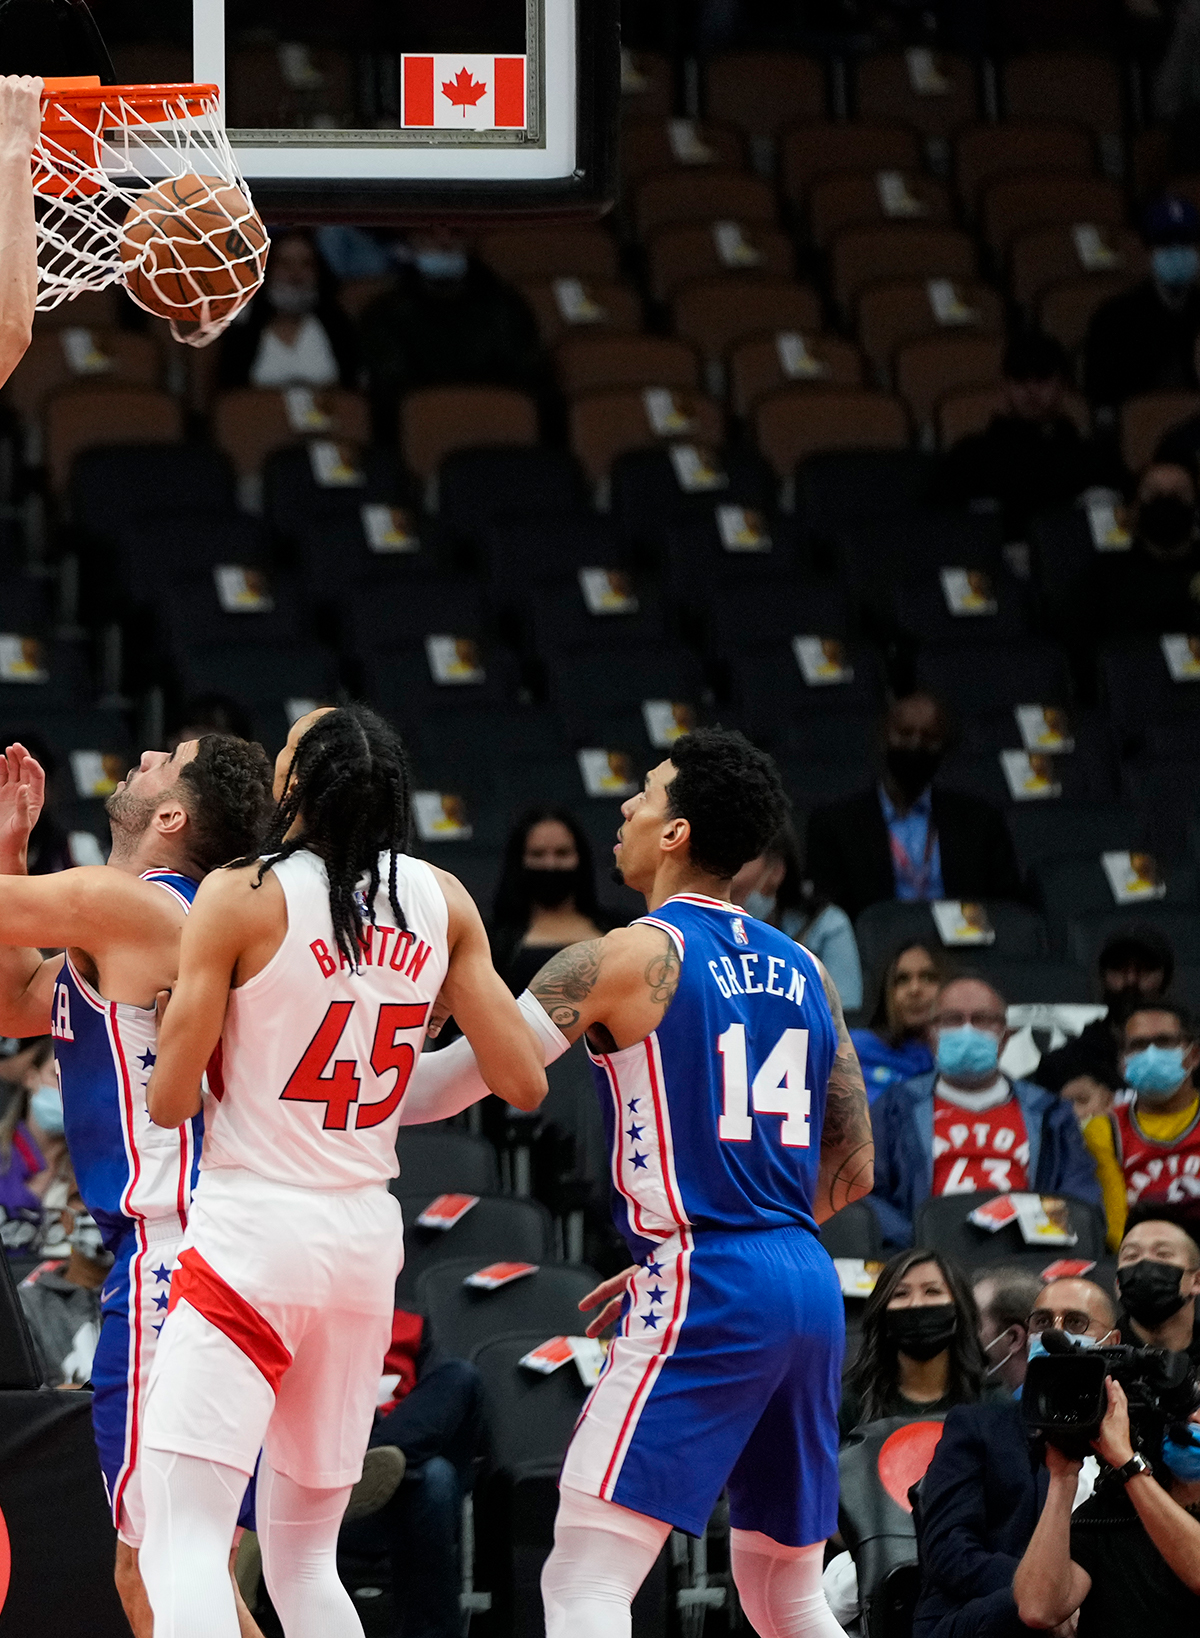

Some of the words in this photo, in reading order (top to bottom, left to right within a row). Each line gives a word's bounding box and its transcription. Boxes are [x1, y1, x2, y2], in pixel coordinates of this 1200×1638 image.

[708, 953, 807, 1006] GREEN
[278, 1000, 431, 1131] 45
[717, 1022, 812, 1148] 14
